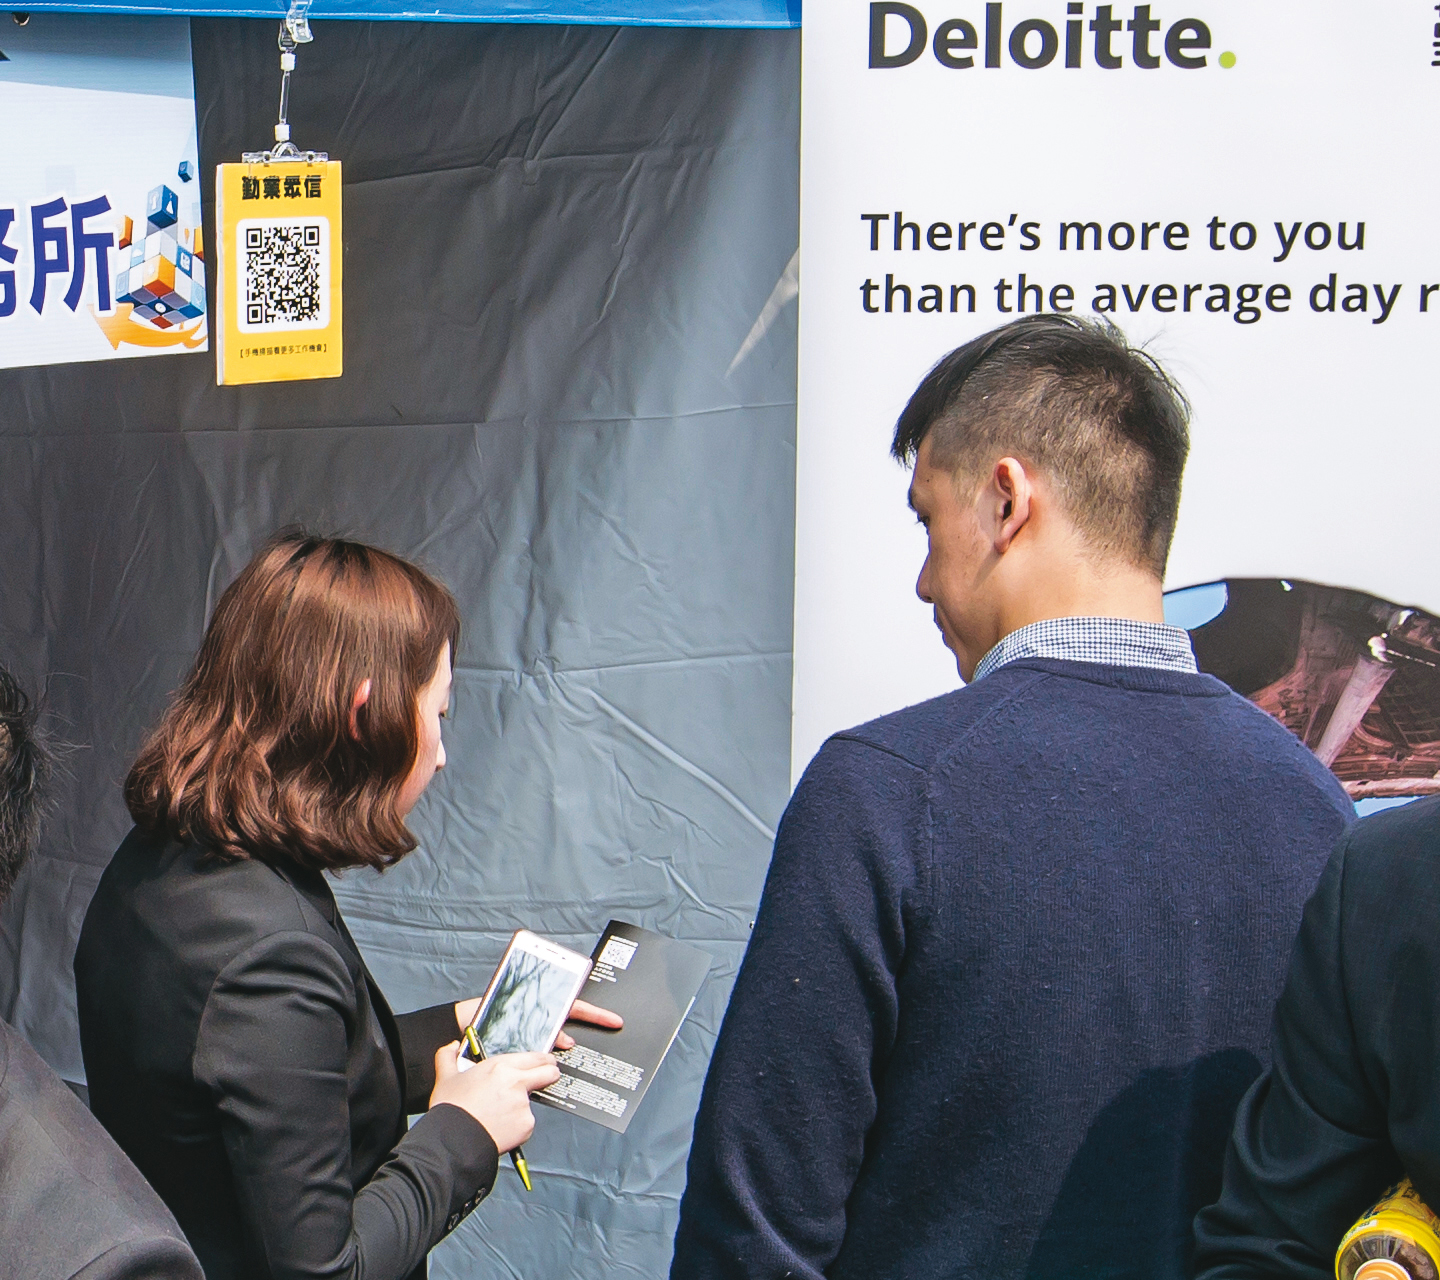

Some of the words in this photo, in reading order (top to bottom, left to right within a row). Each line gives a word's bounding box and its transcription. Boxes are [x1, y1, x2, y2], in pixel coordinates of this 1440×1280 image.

[868, 1, 1237, 70] Deloitte.
[1058, 220, 1190, 252] more
[1206, 215, 1258, 252] to
[1273, 220, 1366, 263] you
[859, 273, 976, 314] than
[993, 273, 1075, 313] the
[1090, 282, 1292, 325] average
[1308, 273, 1403, 325] day
